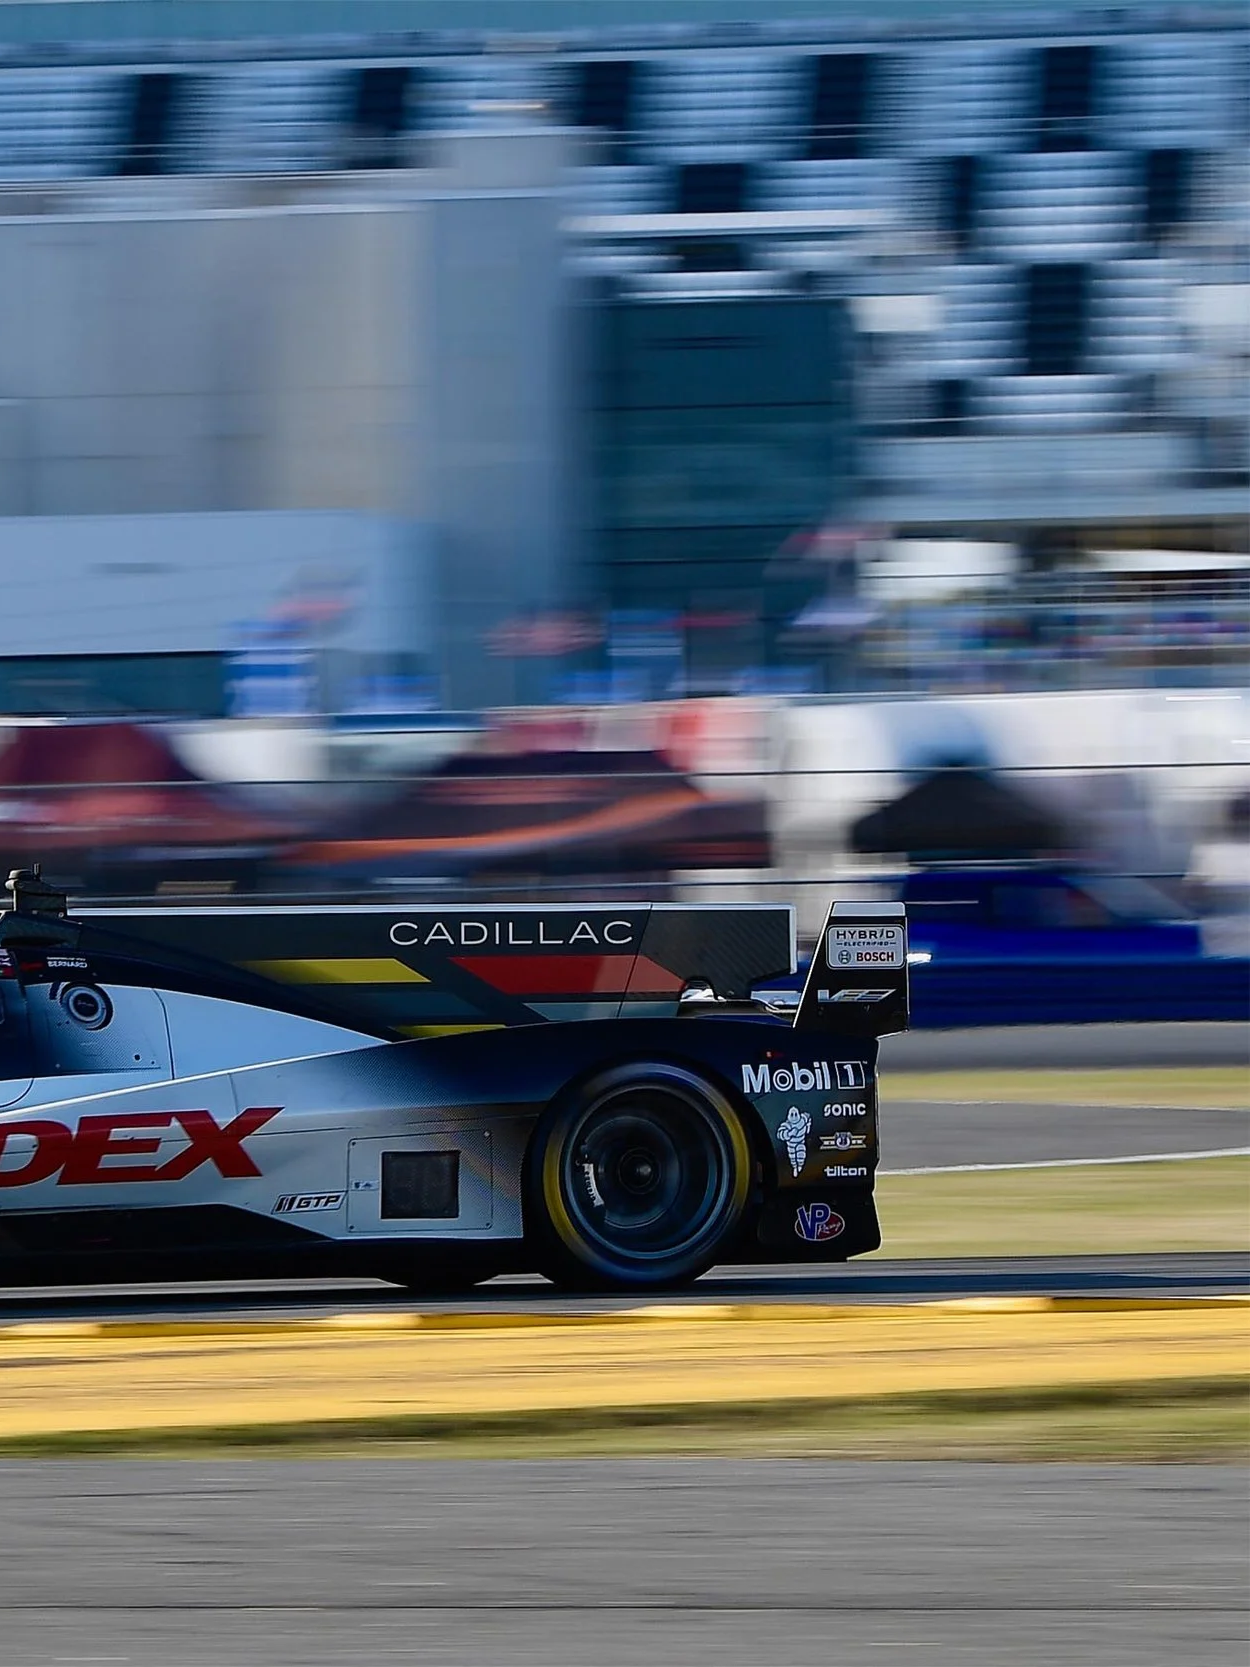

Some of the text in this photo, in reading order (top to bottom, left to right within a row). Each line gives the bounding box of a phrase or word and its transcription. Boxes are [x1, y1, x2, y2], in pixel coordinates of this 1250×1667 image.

[389, 920, 633, 946] CADILLAC
[47, 960, 88, 968] BERNARD
[856, 951, 895, 962] BOSCH
[741, 1061, 832, 1093] Mobil
[824, 1165, 867, 1177] tilton
[295, 1194, 340, 1209] GTP
[796, 1203, 831, 1240] VP
